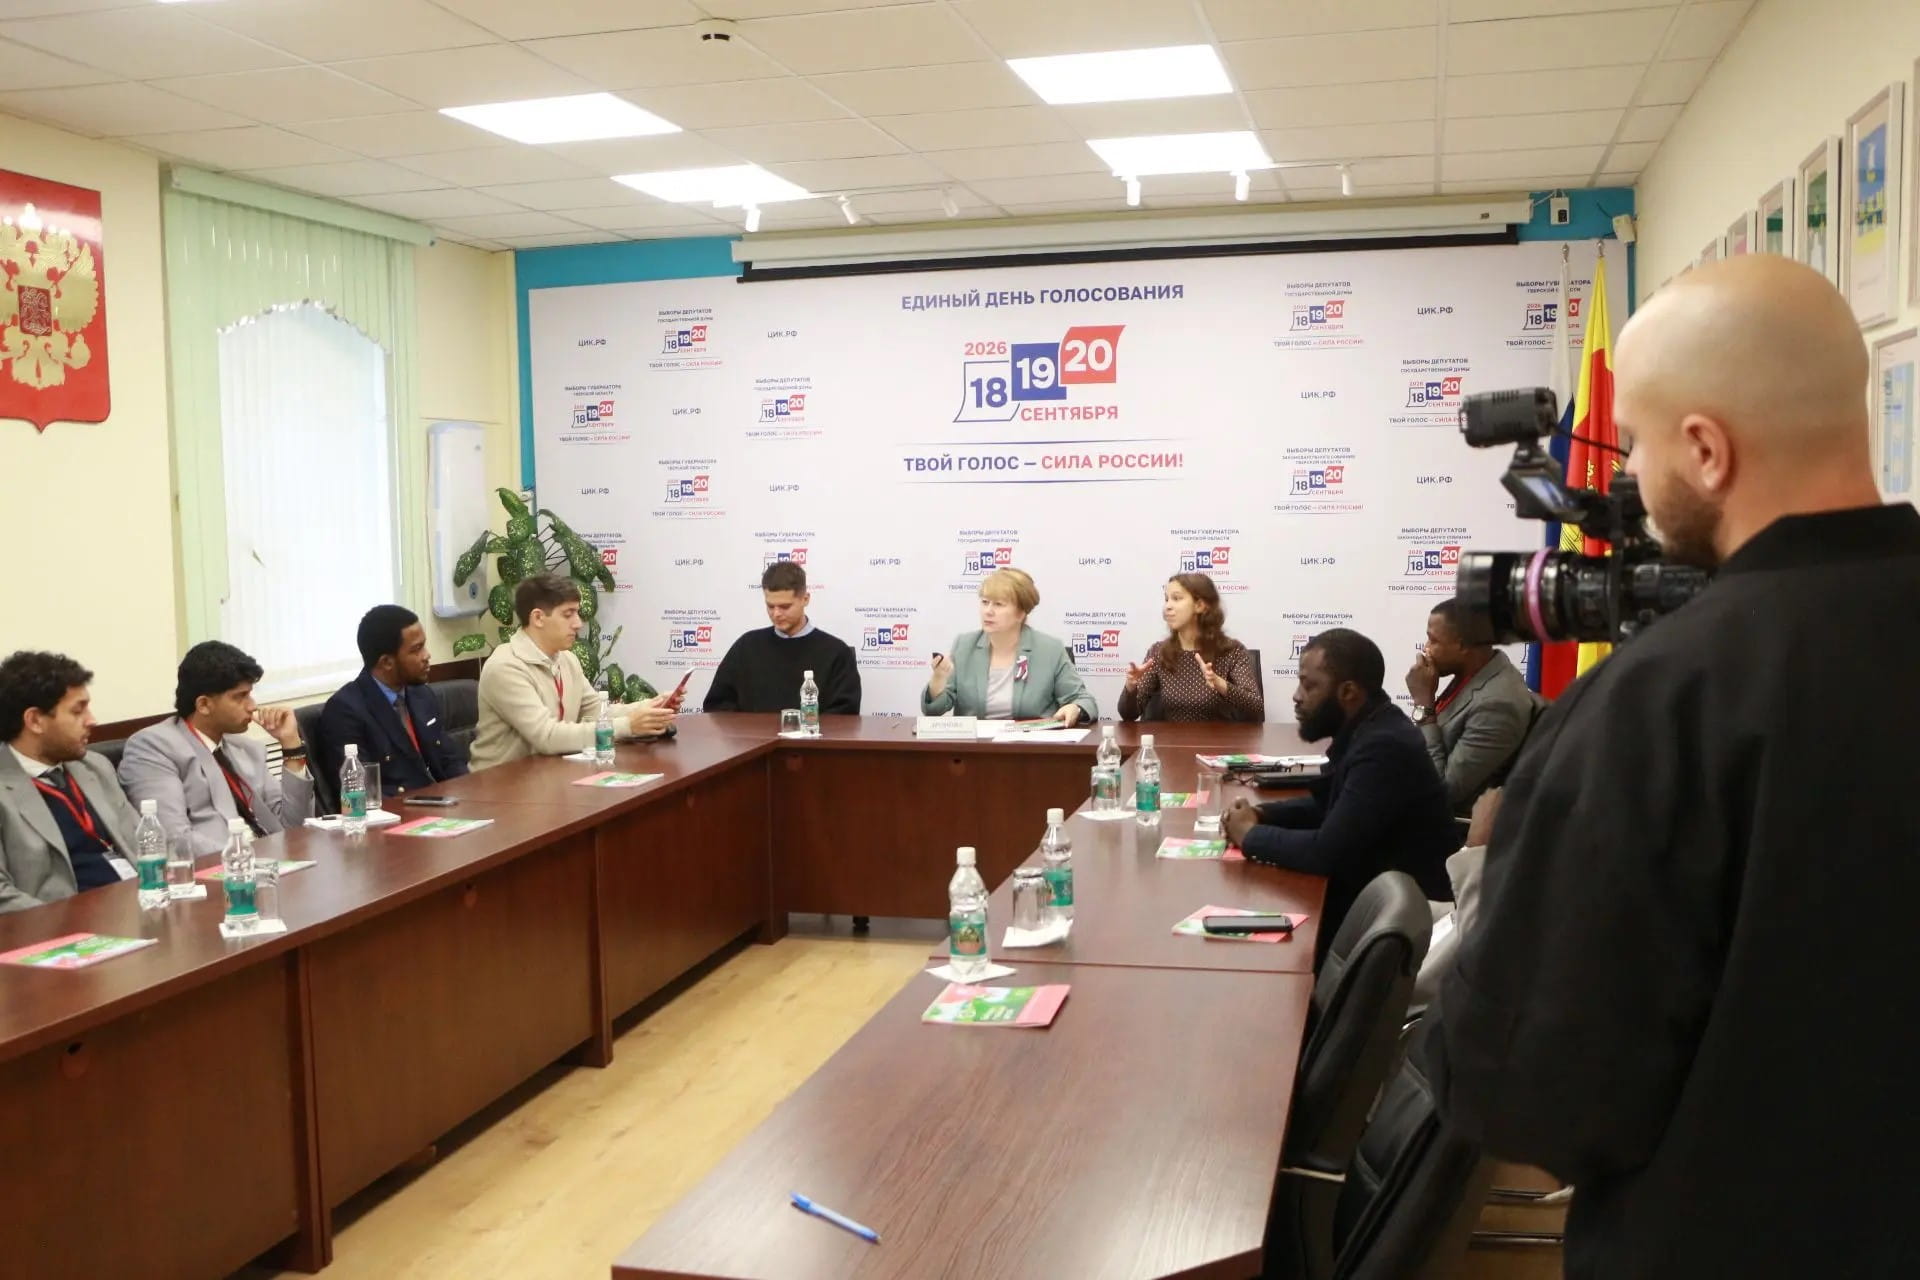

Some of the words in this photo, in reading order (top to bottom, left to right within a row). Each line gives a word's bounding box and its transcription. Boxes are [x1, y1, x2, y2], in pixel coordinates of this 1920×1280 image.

[902, 290, 980, 311] ЕДИНЫЙ
[985, 290, 1034, 308] ДЕНЬ
[1040, 285, 1184, 304] ГОЛОСОВАНИЯ
[1296, 316, 1307, 326] 18
[1311, 310, 1323, 320] 19
[1327, 304, 1341, 314] 20
[1418, 307, 1453, 315] ЦИК.РФ
[1529, 315, 1542, 324] 18
[1545, 309, 1557, 319] 19
[578, 338, 606, 347] ЦИК.РФ
[667, 340, 676, 349] 18
[679, 334, 689, 344] 19
[692, 329, 704, 338] 20
[767, 330, 797, 339] ЦИК.РФ
[965, 342, 1007, 356] 2026
[970, 377, 1007, 408] 18
[1017, 357, 1055, 389] 19
[1065, 339, 1113, 372] 20
[1301, 391, 1336, 399] ЦИК.РФ
[1412, 393, 1424, 402] 18
[1427, 387, 1440, 397] 19
[1443, 381, 1458, 391] 20
[576, 415, 585, 423] 18
[588, 409, 597, 418] 19
[600, 404, 612, 413] 20
[672, 407, 701, 415] ЦИК.РФ
[764, 409, 774, 418] 18
[777, 403, 787, 413] 19
[790, 398, 803, 408] 20
[1021, 406, 1118, 421] СЕНТЯБРЯ
[904, 454, 952, 471] ТВОЙ
[958, 456, 1019, 471] ГОЛОС
[1041, 455, 1092, 469] СИЛА
[1099, 453, 1183, 468] РОССИИ!
[670, 489, 679, 498] 18
[682, 484, 692, 493] 19
[695, 479, 707, 488] 20
[1296, 481, 1307, 490] 18
[1311, 475, 1323, 485] 19
[1326, 470, 1341, 480] 20
[1417, 476, 1452, 484] ЦИК.РФ
[603, 553, 615, 561] 20
[792, 552, 805, 562] 20
[870, 558, 901, 566] ЦИК.РФ
[968, 562, 978, 570] 18
[982, 556, 992, 565] 19
[996, 551, 1009, 561] 20
[1184, 561, 1194, 570] 18
[1198, 555, 1209, 565] 19
[1213, 551, 1227, 560] 20
[1411, 561, 1423, 570] 18
[1426, 555, 1438, 565] 19
[1442, 550, 1457, 560] 20
[673, 640, 682, 648] 18
[685, 634, 695, 643] 19
[698, 630, 710, 639] 20
[867, 638, 876, 646] 18
[880, 632, 890, 641] 19
[893, 627, 906, 637] 20
[1074, 644, 1085, 653] 18
[1088, 638, 1099, 648] 19
[1103, 634, 1117, 643] 20
